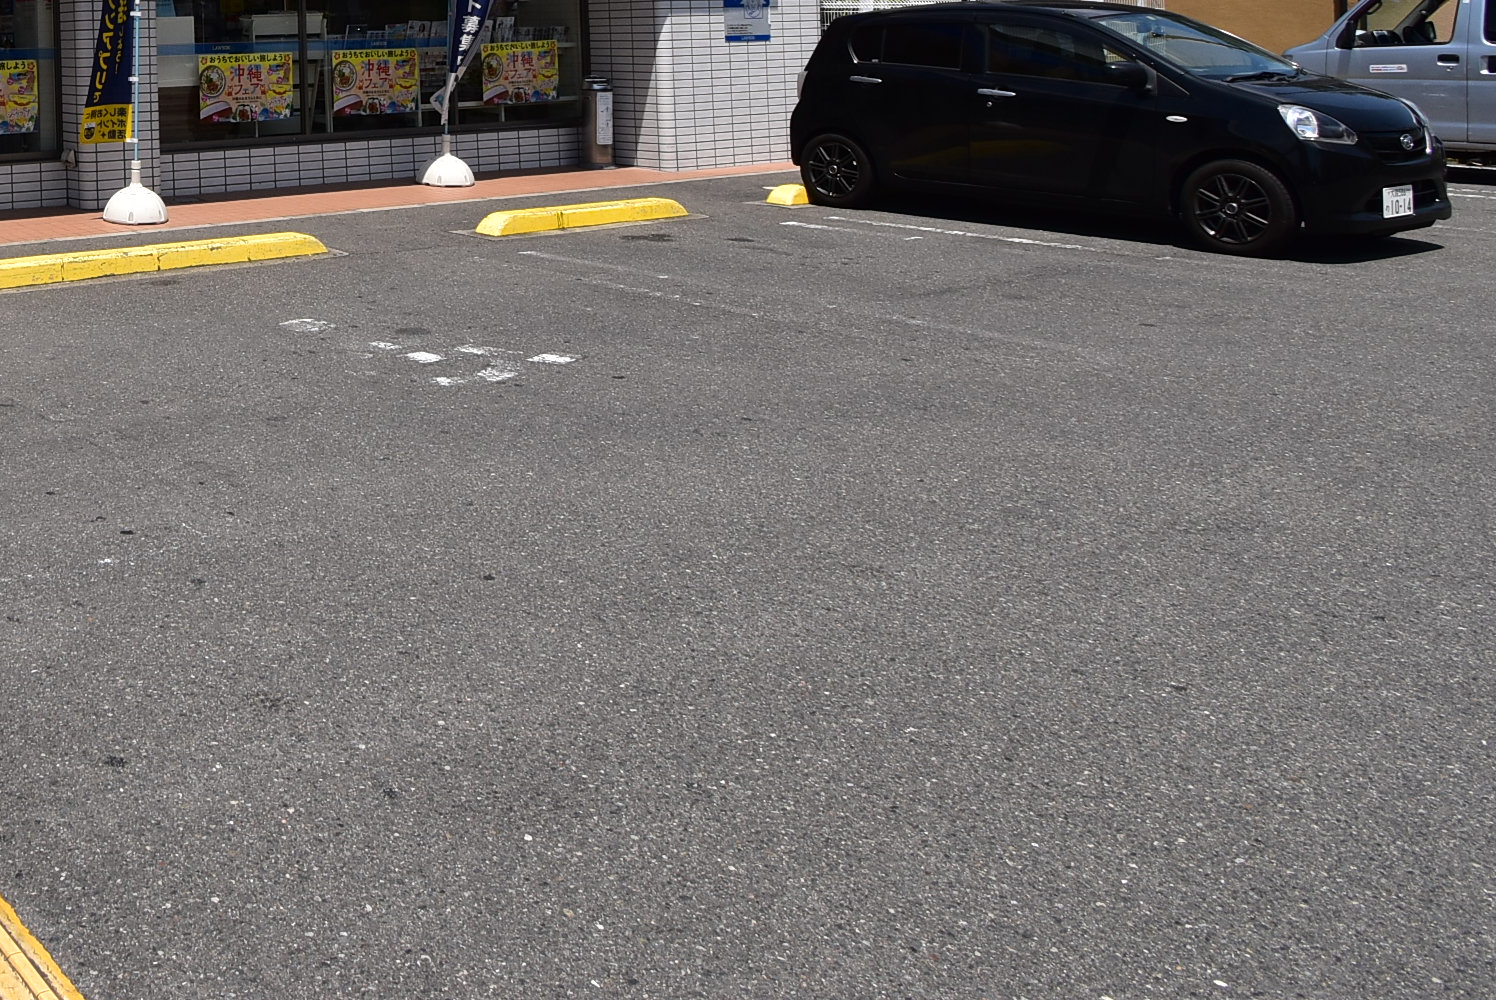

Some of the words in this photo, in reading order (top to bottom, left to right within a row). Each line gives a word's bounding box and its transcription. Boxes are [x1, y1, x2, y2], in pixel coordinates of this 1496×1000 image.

[209, 53, 283, 63] おうちでおいしい旅しよう
[229, 64, 263, 83] 沖縄
[361, 59, 391, 77] 沖縄
[233, 83, 260, 96] フェア
[364, 77, 388, 89] フェア
